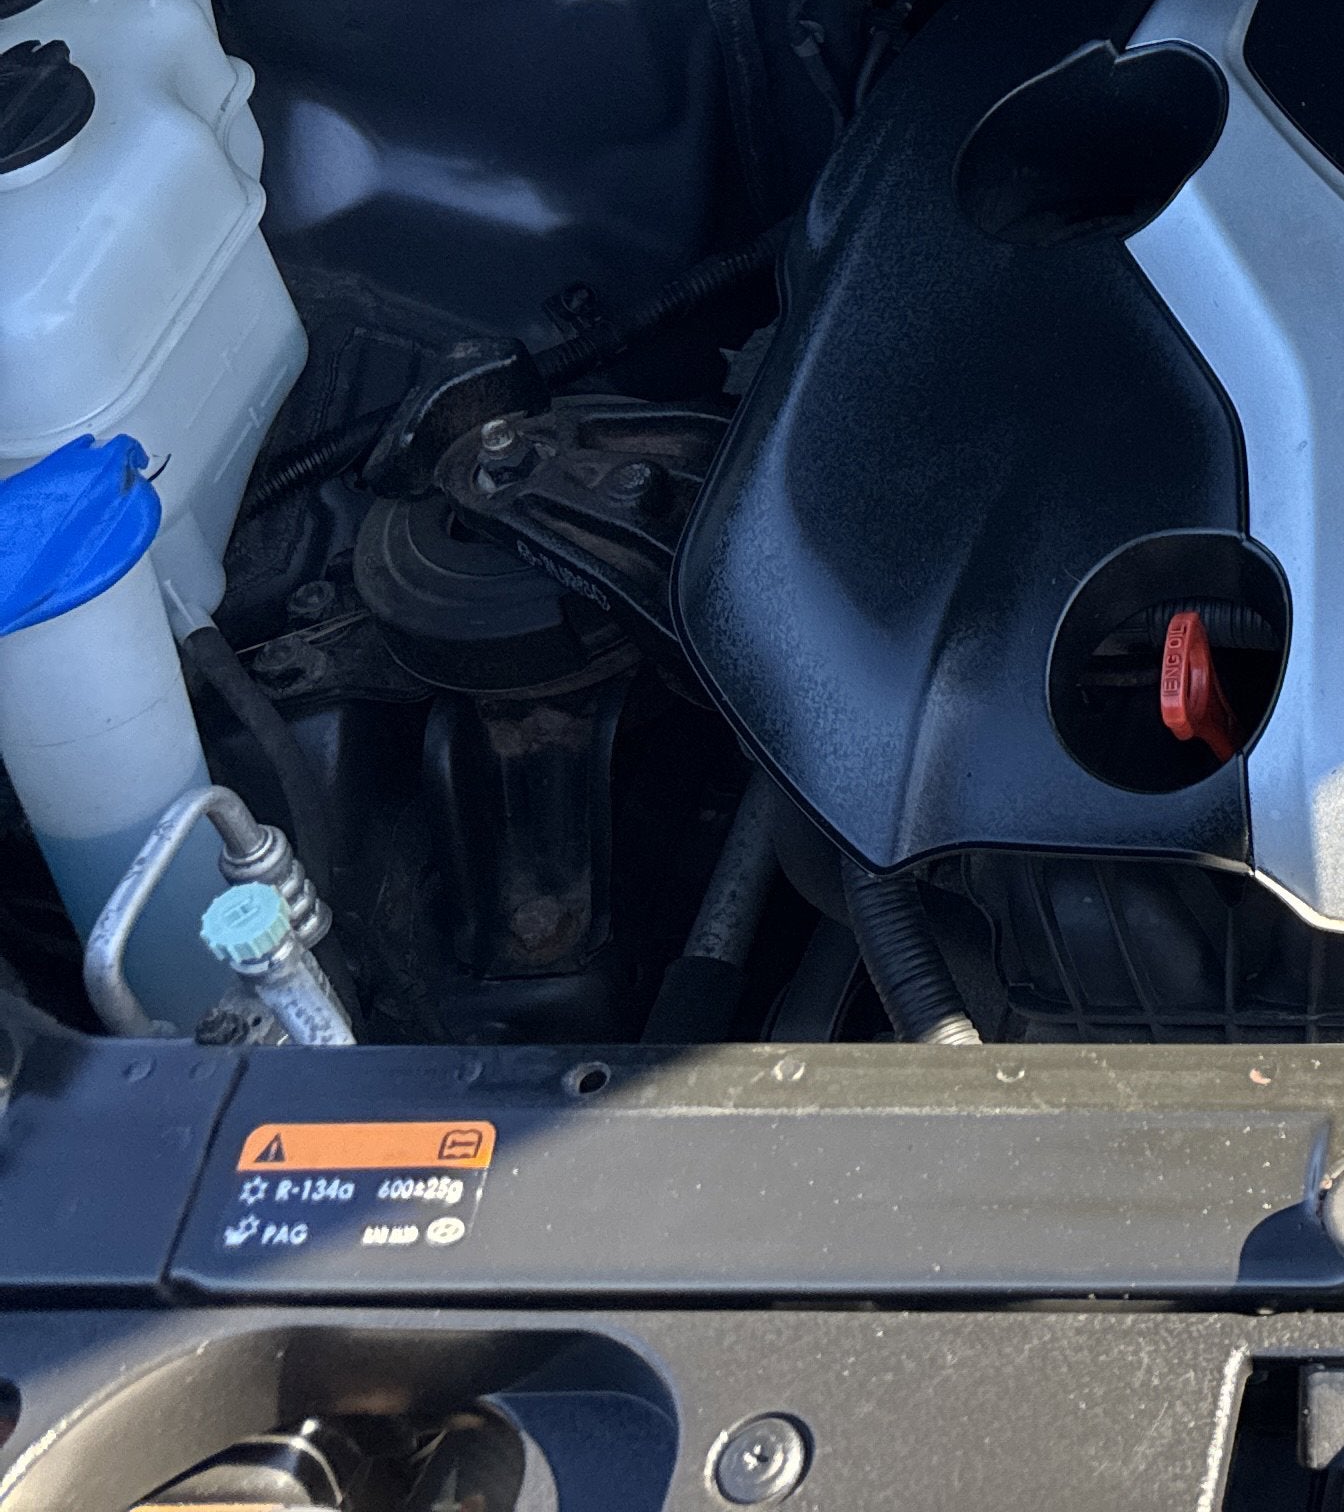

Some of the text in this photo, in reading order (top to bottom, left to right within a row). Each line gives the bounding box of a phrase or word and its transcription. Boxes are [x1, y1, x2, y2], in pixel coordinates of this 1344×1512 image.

[1163, 623, 1186, 693] ENG OIL
[274, 1177, 356, 1202] R-134a
[260, 1224, 309, 1246] PAG
